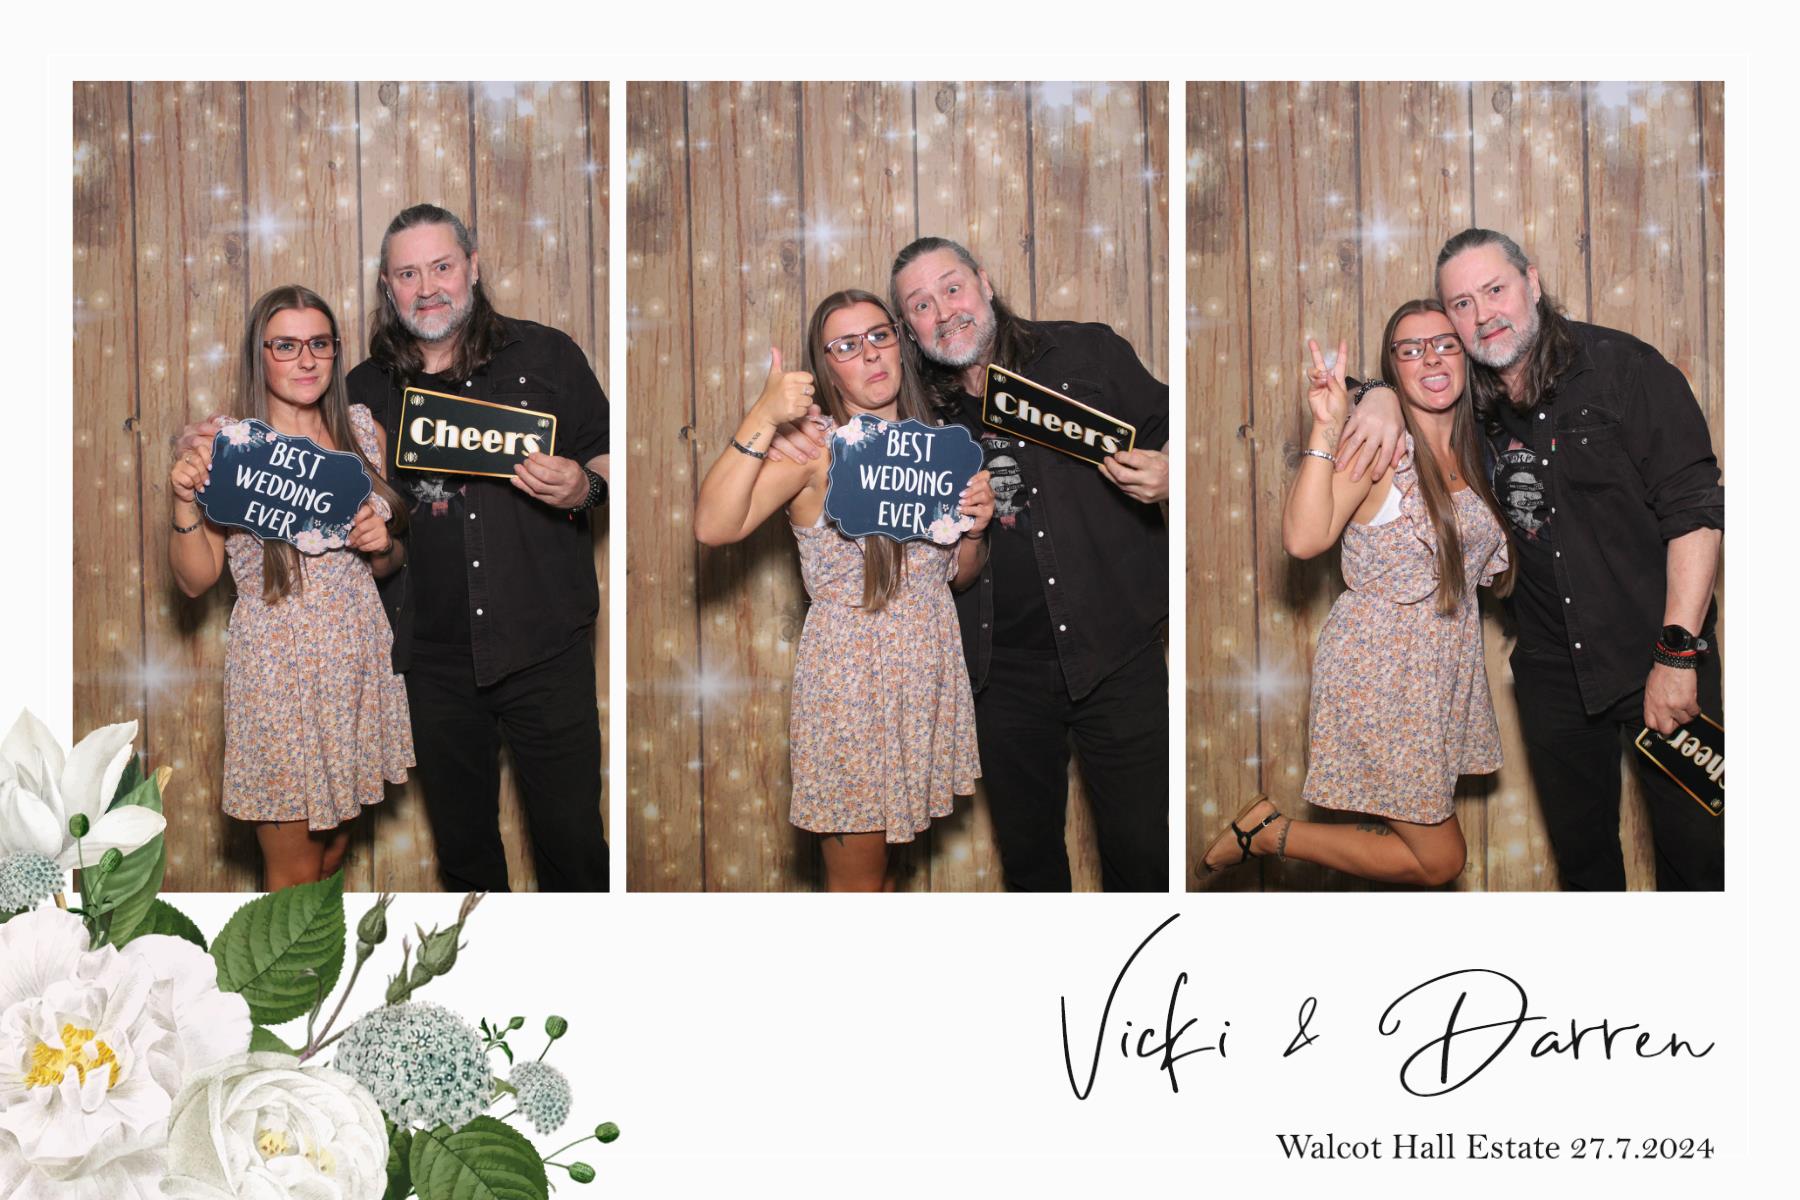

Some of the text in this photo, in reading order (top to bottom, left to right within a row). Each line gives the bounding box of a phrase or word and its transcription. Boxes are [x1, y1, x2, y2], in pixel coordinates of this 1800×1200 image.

[410, 417, 541, 457] Cheers
[994, 391, 1120, 454] Cheers
[269, 442, 326, 480] BEST
[887, 429, 936, 464] BEST
[236, 464, 334, 514] WEDDING
[859, 464, 954, 497] WEDDING
[244, 501, 297, 539] EVER
[878, 501, 926, 534] EVER
[1657, 729, 1724, 790] heer
